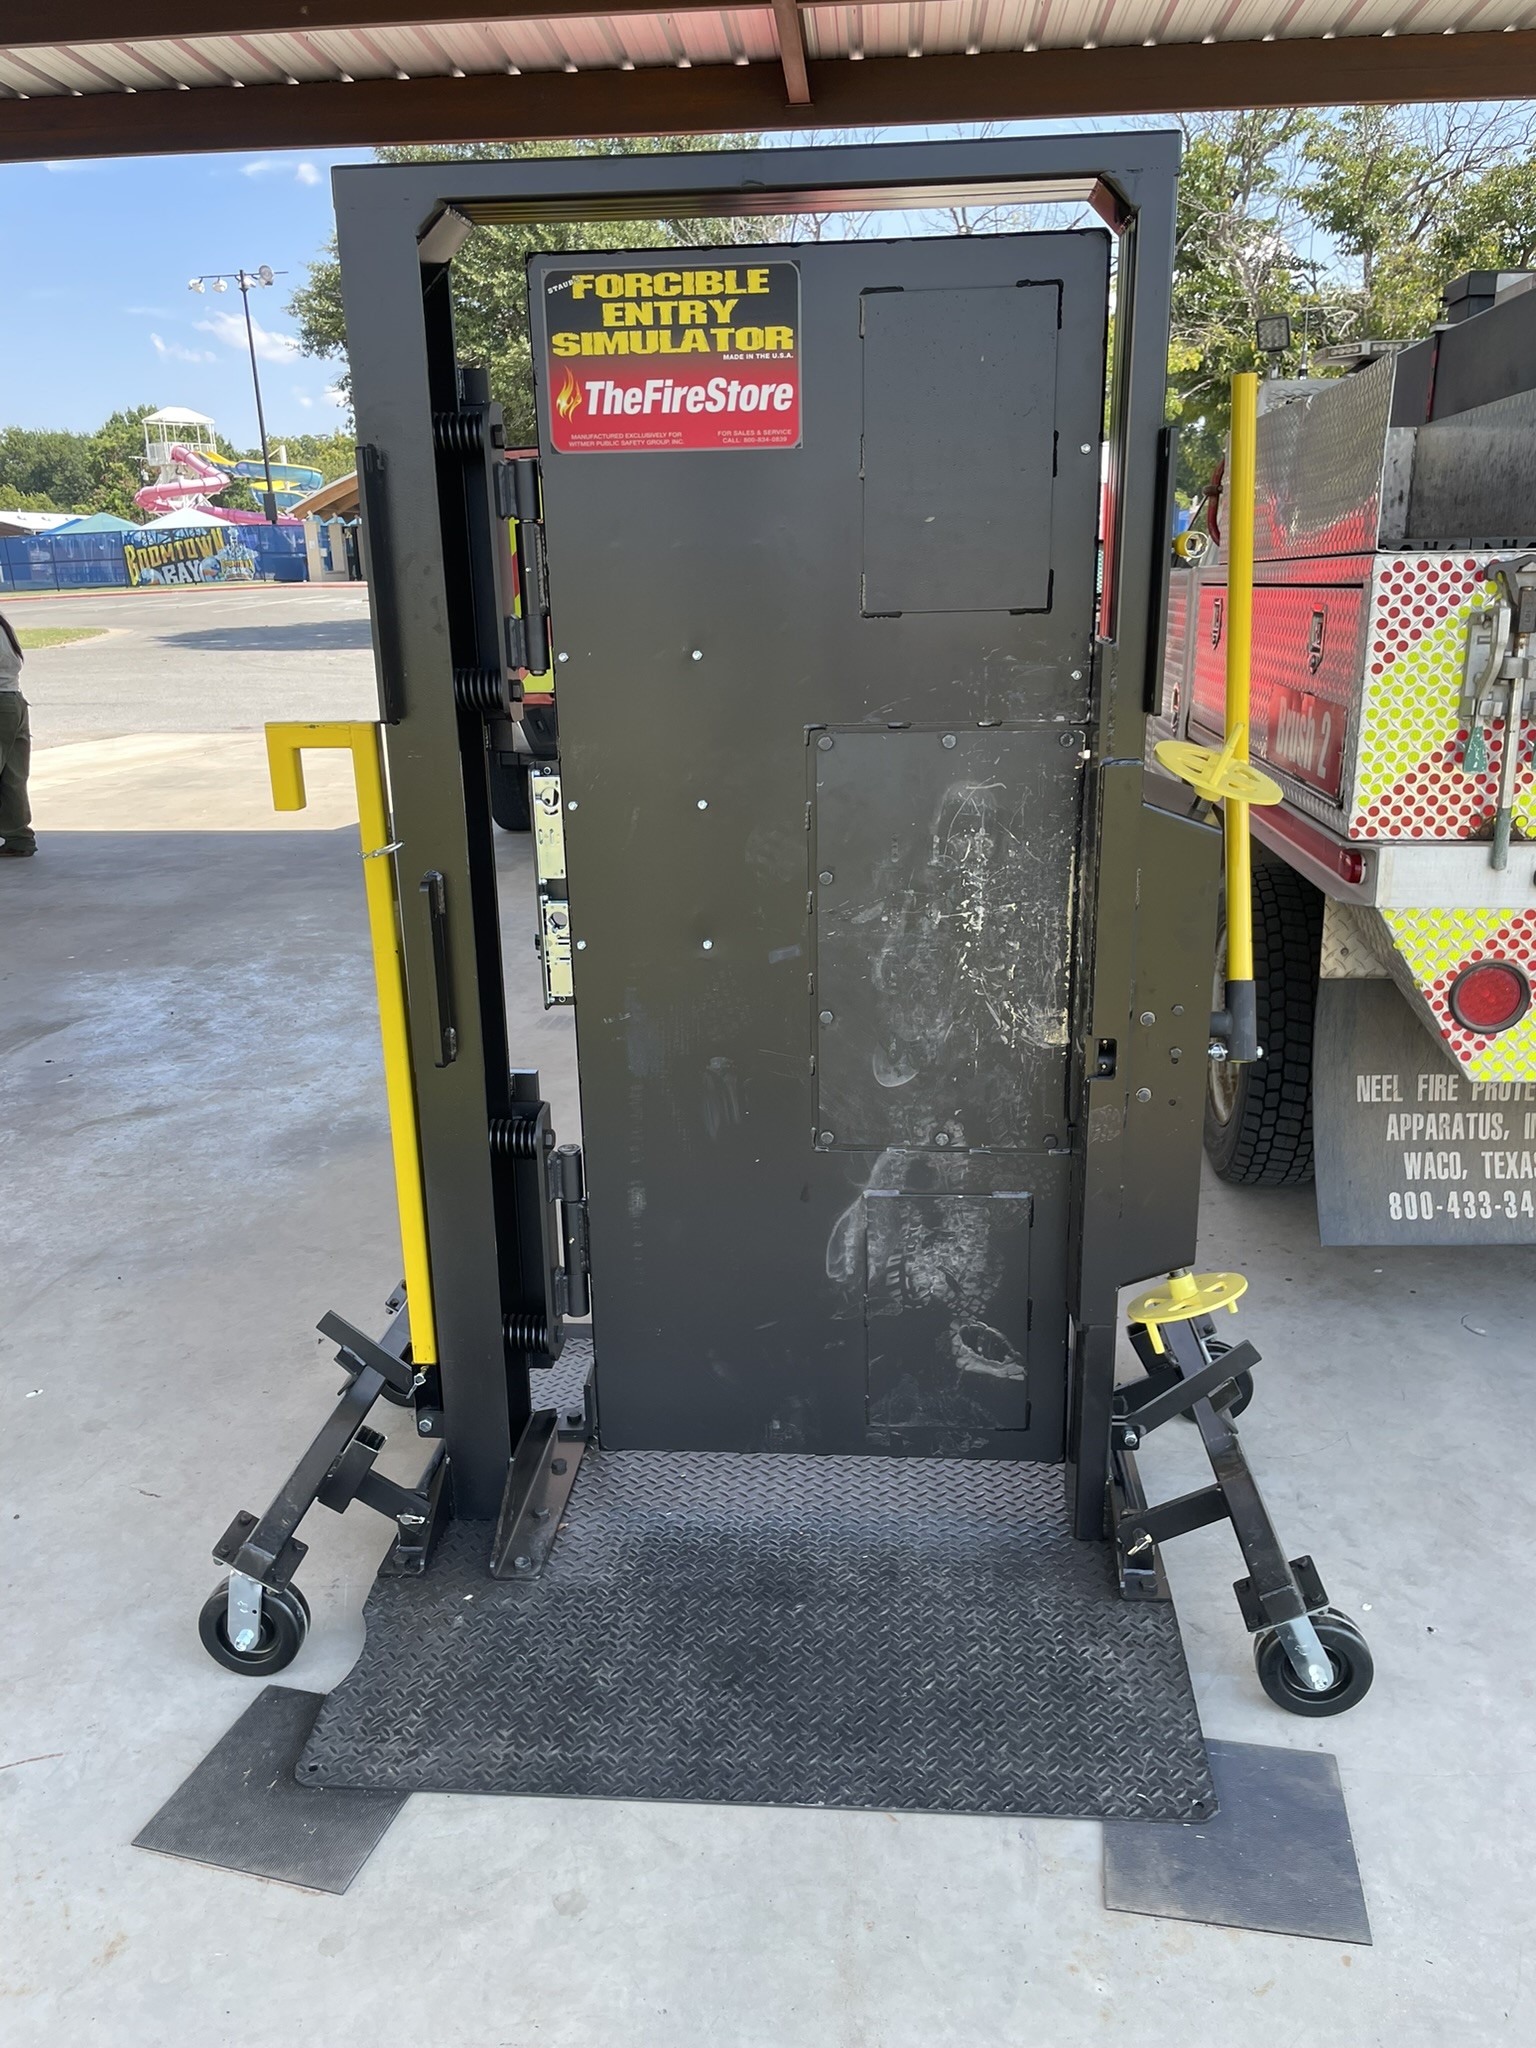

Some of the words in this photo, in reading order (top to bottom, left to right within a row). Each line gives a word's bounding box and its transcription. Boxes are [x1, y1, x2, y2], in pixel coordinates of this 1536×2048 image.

[572, 269, 769, 299] FORCIBLE
[602, 299, 739, 327] ENTRY
[552, 326, 794, 356] SIMULATOR
[585, 377, 793, 415] TheFireStore
[571, 432, 624, 440] MANUFACTURED
[124, 527, 225, 586] BOOMTOWN
[161, 559, 201, 585] BAY
[1276, 696, 1315, 771] Brush
[1317, 711, 1331, 779] 2
[1356, 1074, 1403, 1102] NEEL
[1417, 1074, 1459, 1102] FIRE
[1386, 1112, 1510, 1141] APPARATUS,
[1403, 1151, 1468, 1180] WACO,
[1481, 1150, 1536, 1180] TEXA
[1388, 1190, 1535, 1220] 800-433-34
